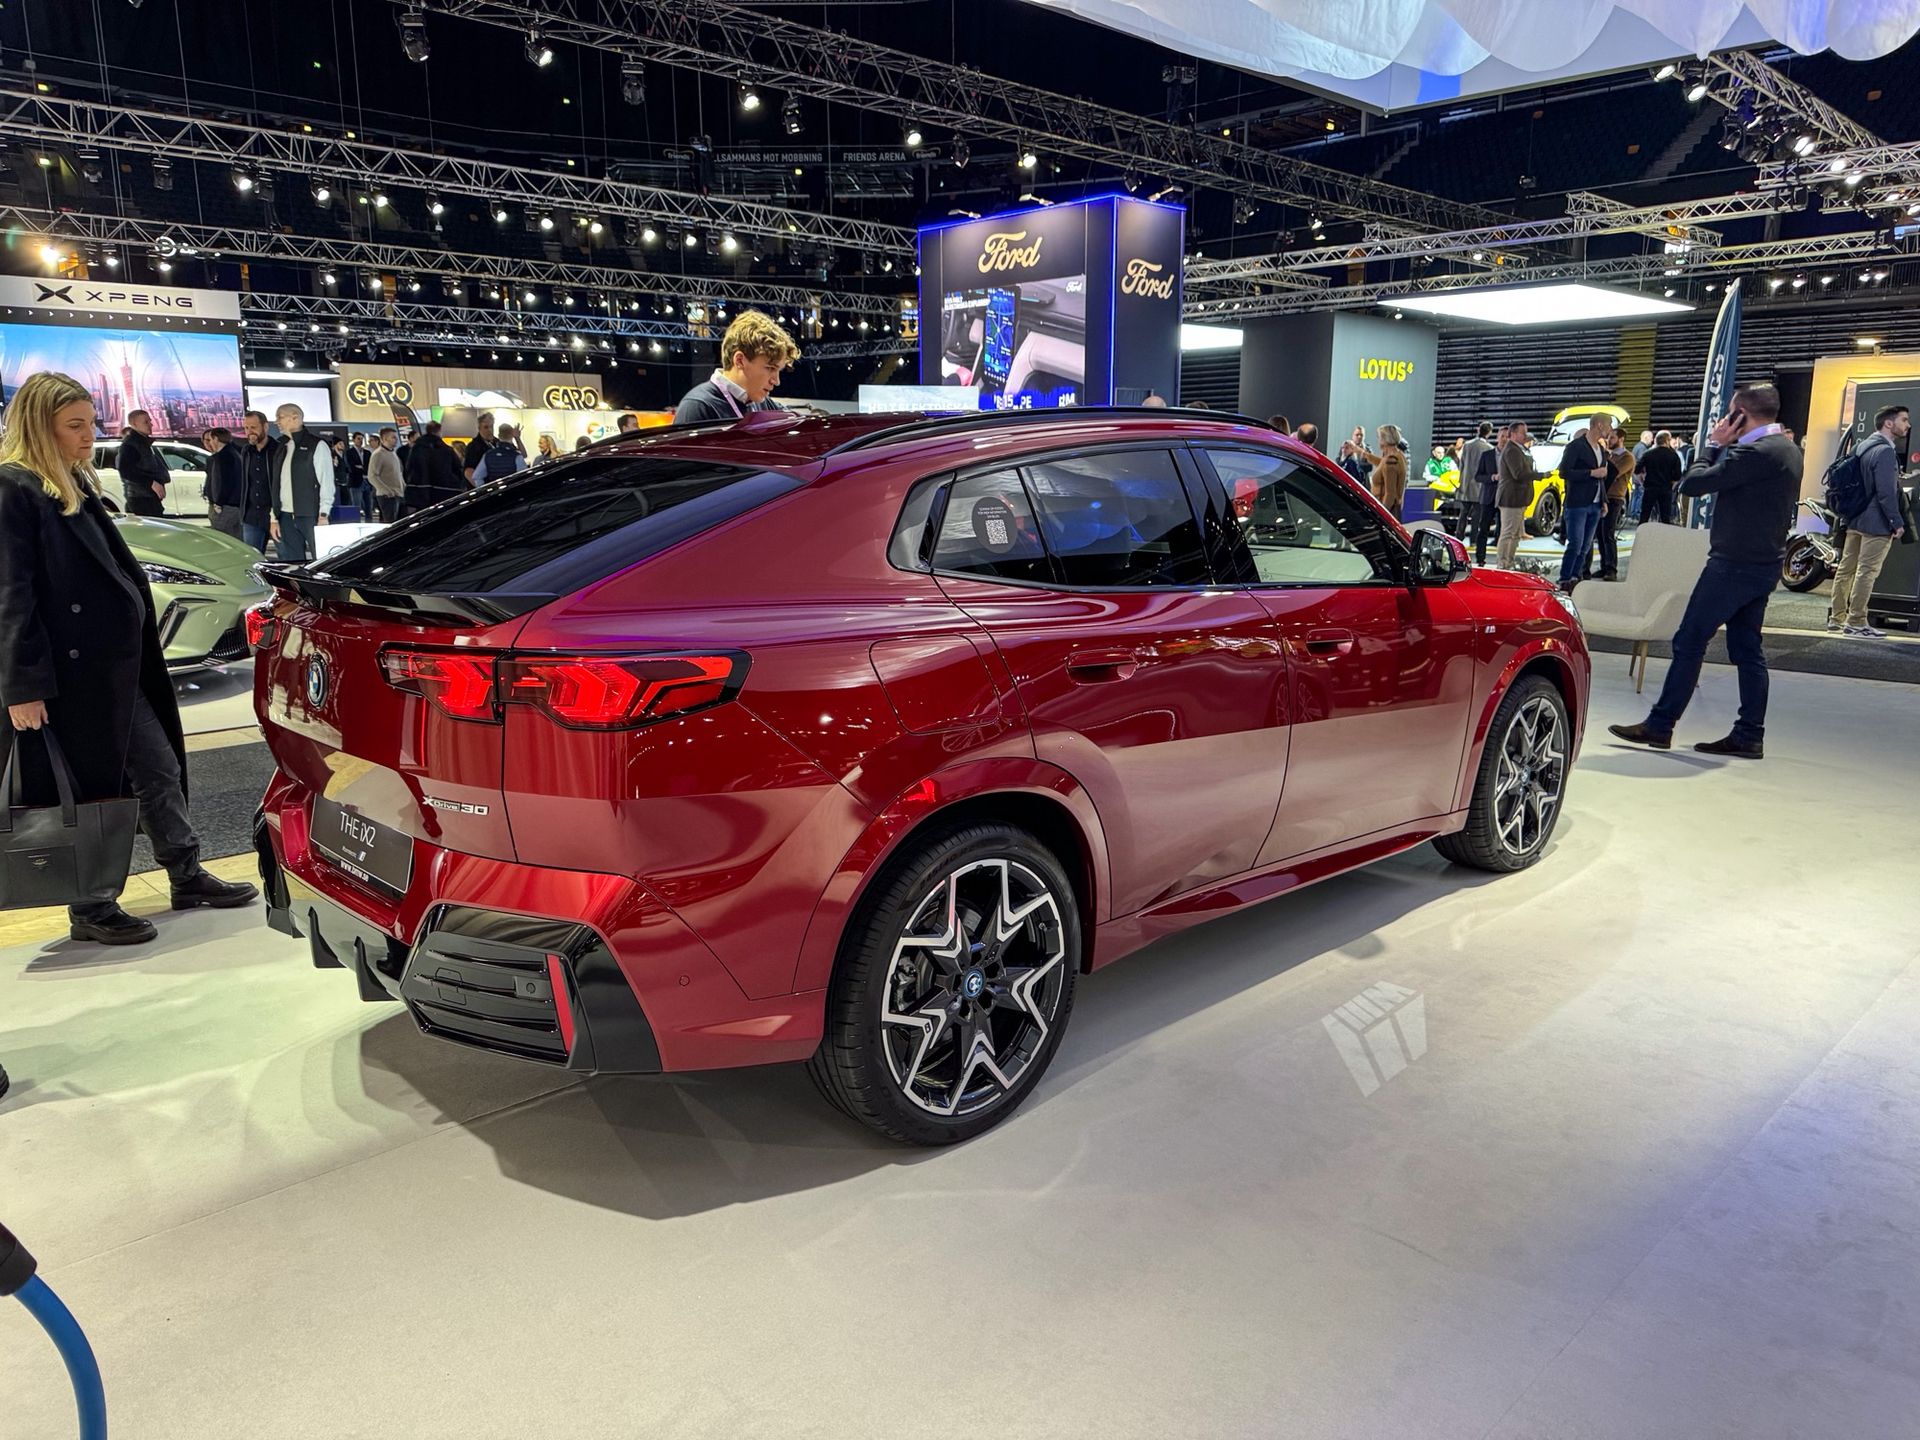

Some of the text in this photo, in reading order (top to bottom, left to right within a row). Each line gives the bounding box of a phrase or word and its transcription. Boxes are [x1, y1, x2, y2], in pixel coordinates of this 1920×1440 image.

[714, 152, 823, 163] LSAMMANS MOT MOBBNING
[843, 151, 907, 161] FRIENDS ARENA
[977, 230, 1043, 273] Ford
[1121, 258, 1175, 300] Ford
[85, 290, 193, 308] XPENG
[1359, 358, 1406, 382] LOTUS
[346, 379, 414, 407] CARO
[340, 811, 376, 848] THE iX2
